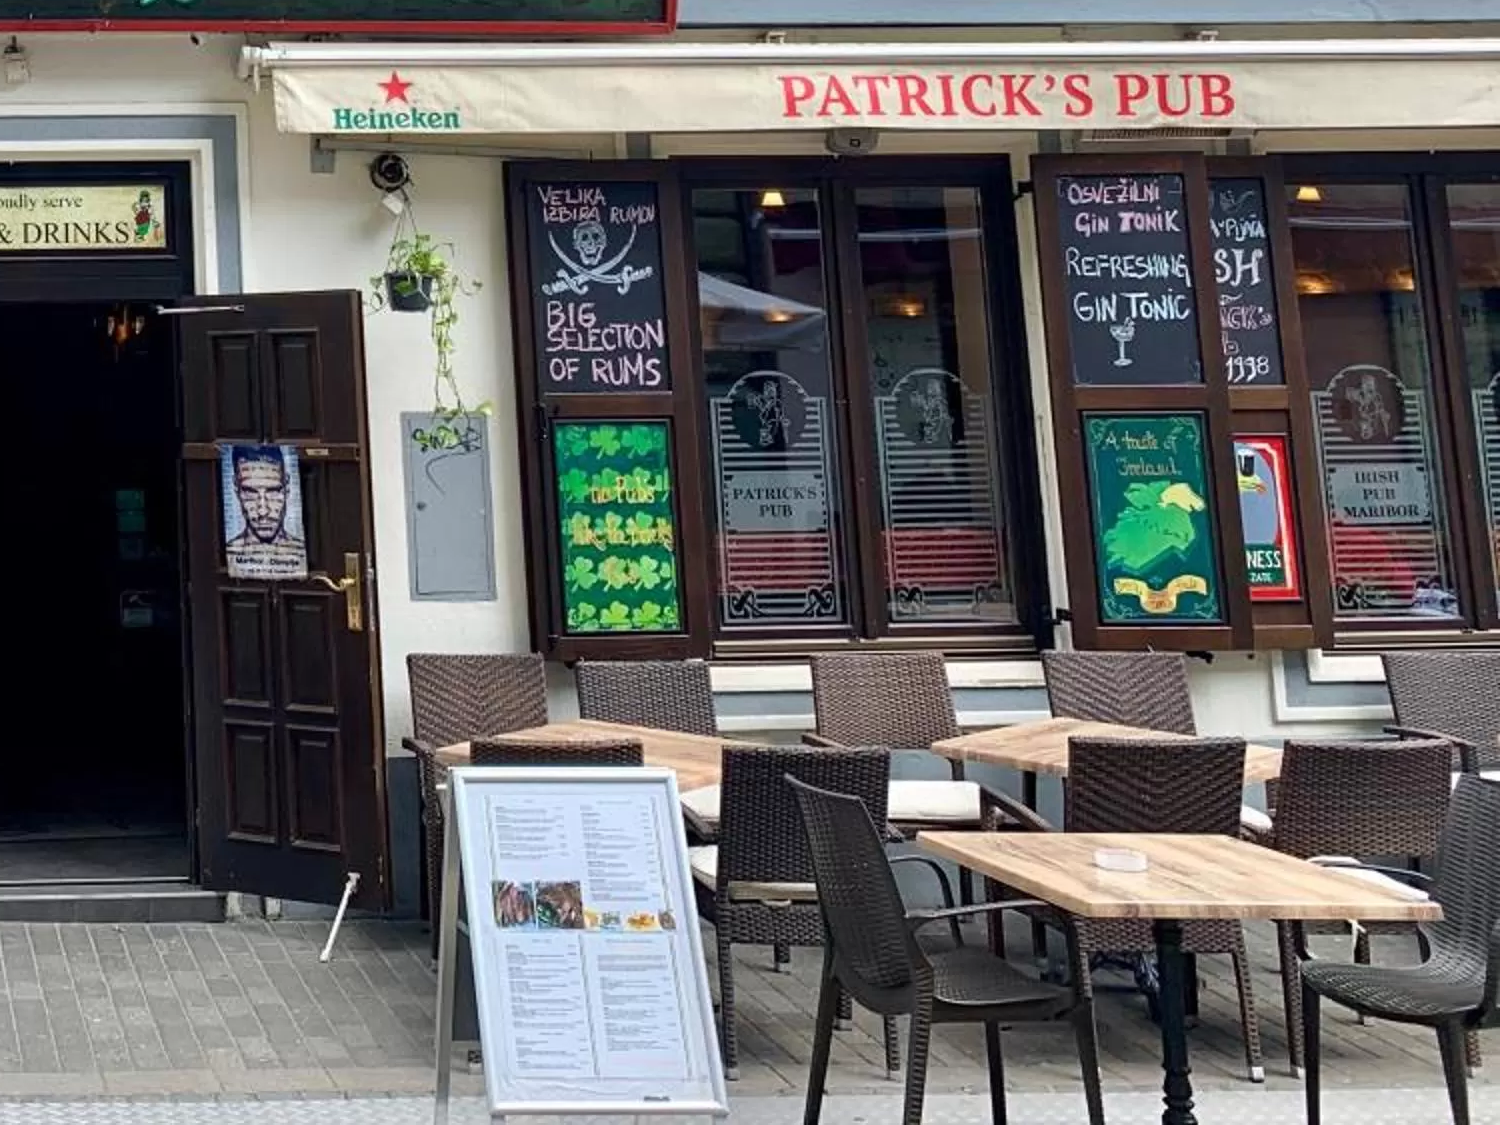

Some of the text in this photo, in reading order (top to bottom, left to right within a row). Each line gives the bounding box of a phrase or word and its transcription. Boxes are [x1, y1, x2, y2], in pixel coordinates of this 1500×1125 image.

[777, 73, 1236, 118] PATRICK'S PUB
[332, 107, 460, 130] Heineken
[42, 194, 84, 208] serve
[537, 186, 606, 206] VELIKA
[22, 221, 130, 245] DRINKS
[1065, 247, 1192, 288] REFRESHING
[547, 300, 597, 328] BIG
[1073, 291, 1117, 322] GIN
[546, 319, 665, 352] SELECTION
[550, 352, 662, 386] OF RUMS
[1226, 355, 1270, 383] 1998
[1355, 471, 1399, 484] IRISH
[1363, 488, 1396, 500] PUB
[759, 503, 793, 517] PUB
[1343, 504, 1420, 518] MARIBOR
